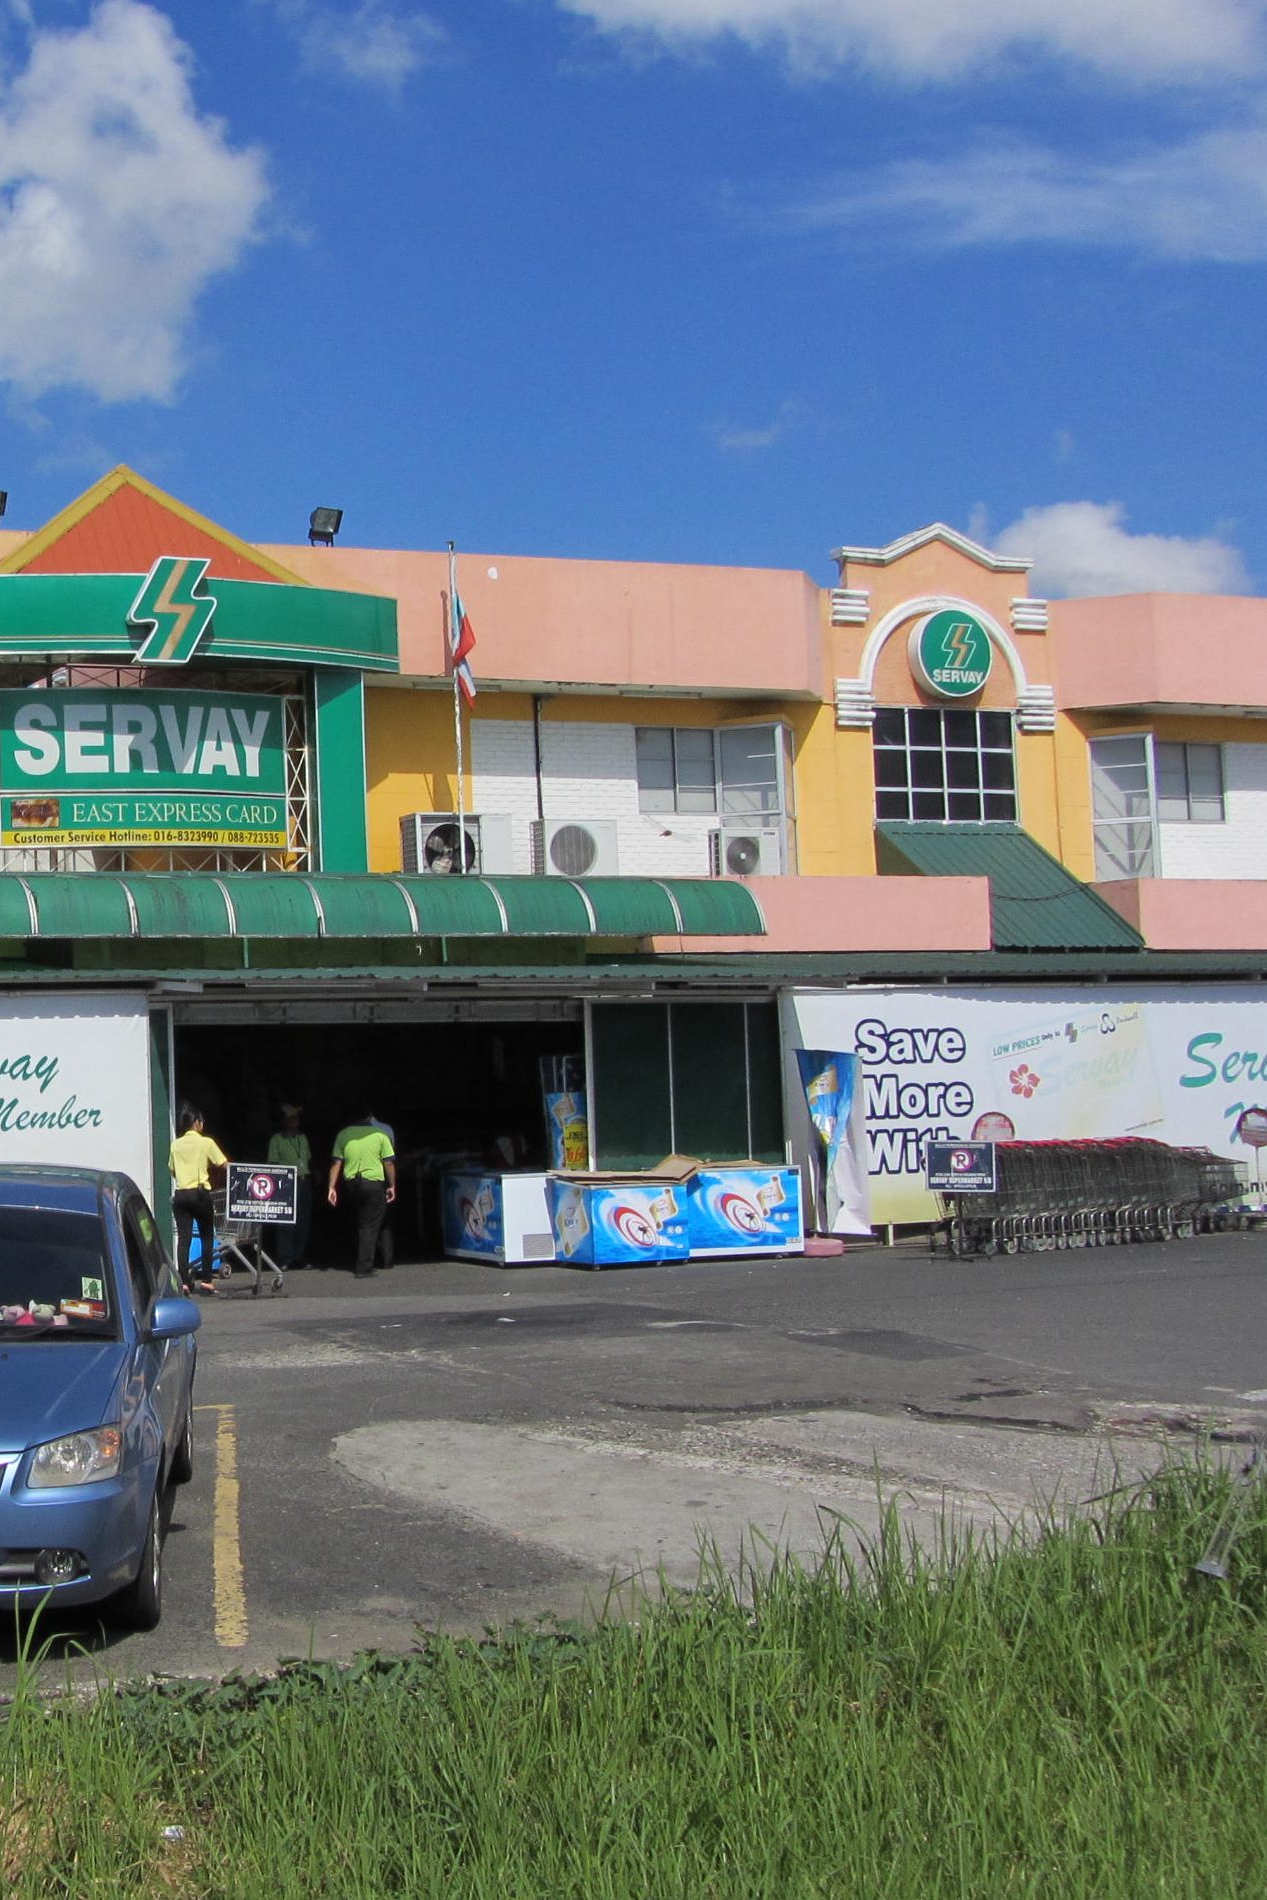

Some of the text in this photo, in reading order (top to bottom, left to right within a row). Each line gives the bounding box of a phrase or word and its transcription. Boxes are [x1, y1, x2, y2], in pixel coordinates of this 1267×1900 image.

[932, 669, 984, 684] SERVAY
[14, 703, 271, 777] SERVAY
[72, 803, 128, 822] EAST
[135, 802, 222, 822] EXPRESS
[226, 804, 277, 824] CARD
[13, 832, 64, 844] Customer
[68, 831, 106, 843] Service
[109, 830, 152, 842] Hotline:
[153, 831, 219, 842] 016-8323990
[227, 832, 280, 844] 088-723535
[855, 1018, 967, 1066] Save
[992, 1043, 1010, 1057] LOW
[1011, 1036, 1041, 1051] PRICES
[862, 1073, 974, 1120] More
